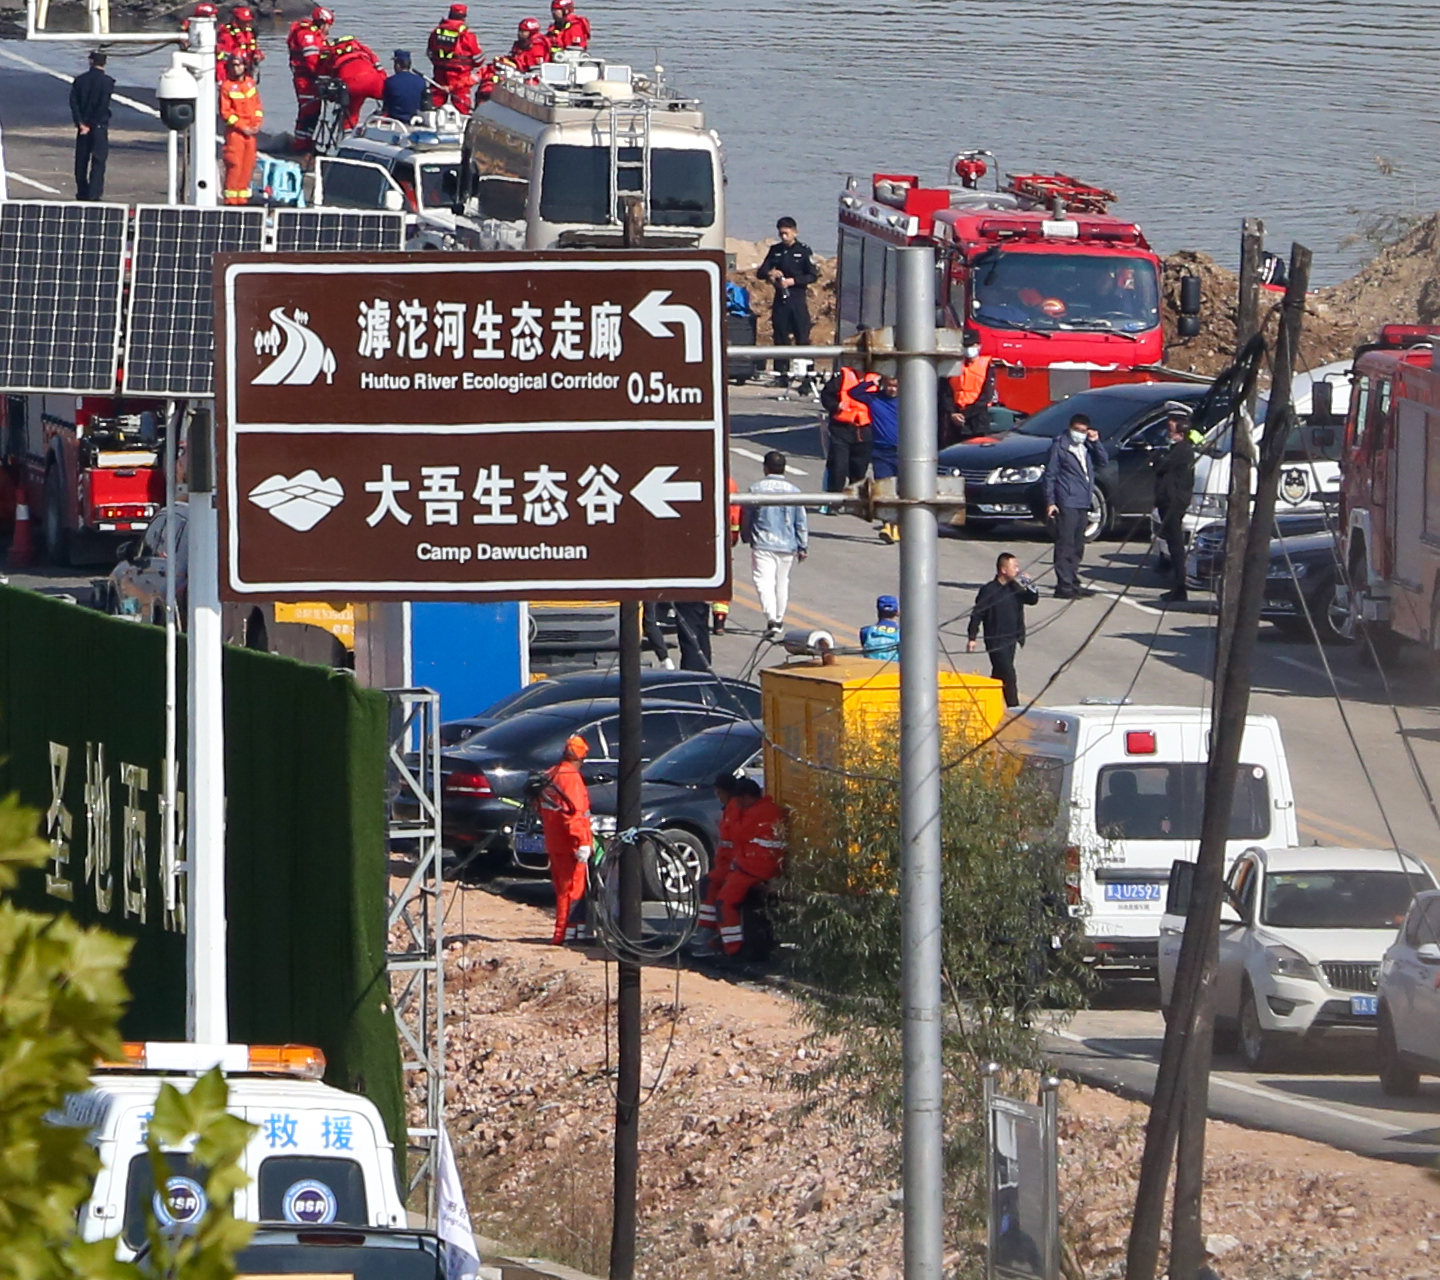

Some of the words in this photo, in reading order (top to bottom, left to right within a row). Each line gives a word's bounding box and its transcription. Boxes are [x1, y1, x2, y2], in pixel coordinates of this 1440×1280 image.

[358, 299, 623, 362] 滹沱河生态走廊
[361, 373, 411, 390] Hutuo
[414, 372, 458, 390] River
[462, 371, 547, 393] Ecological
[550, 371, 620, 390] Corridor
[627, 371, 703, 405] 0.5km
[364, 463, 624, 527] 大吾生态谷
[416, 543, 471, 563] Camp
[477, 542, 588, 561] Dawuchuan
[295, 1200, 326, 1215] BSR
